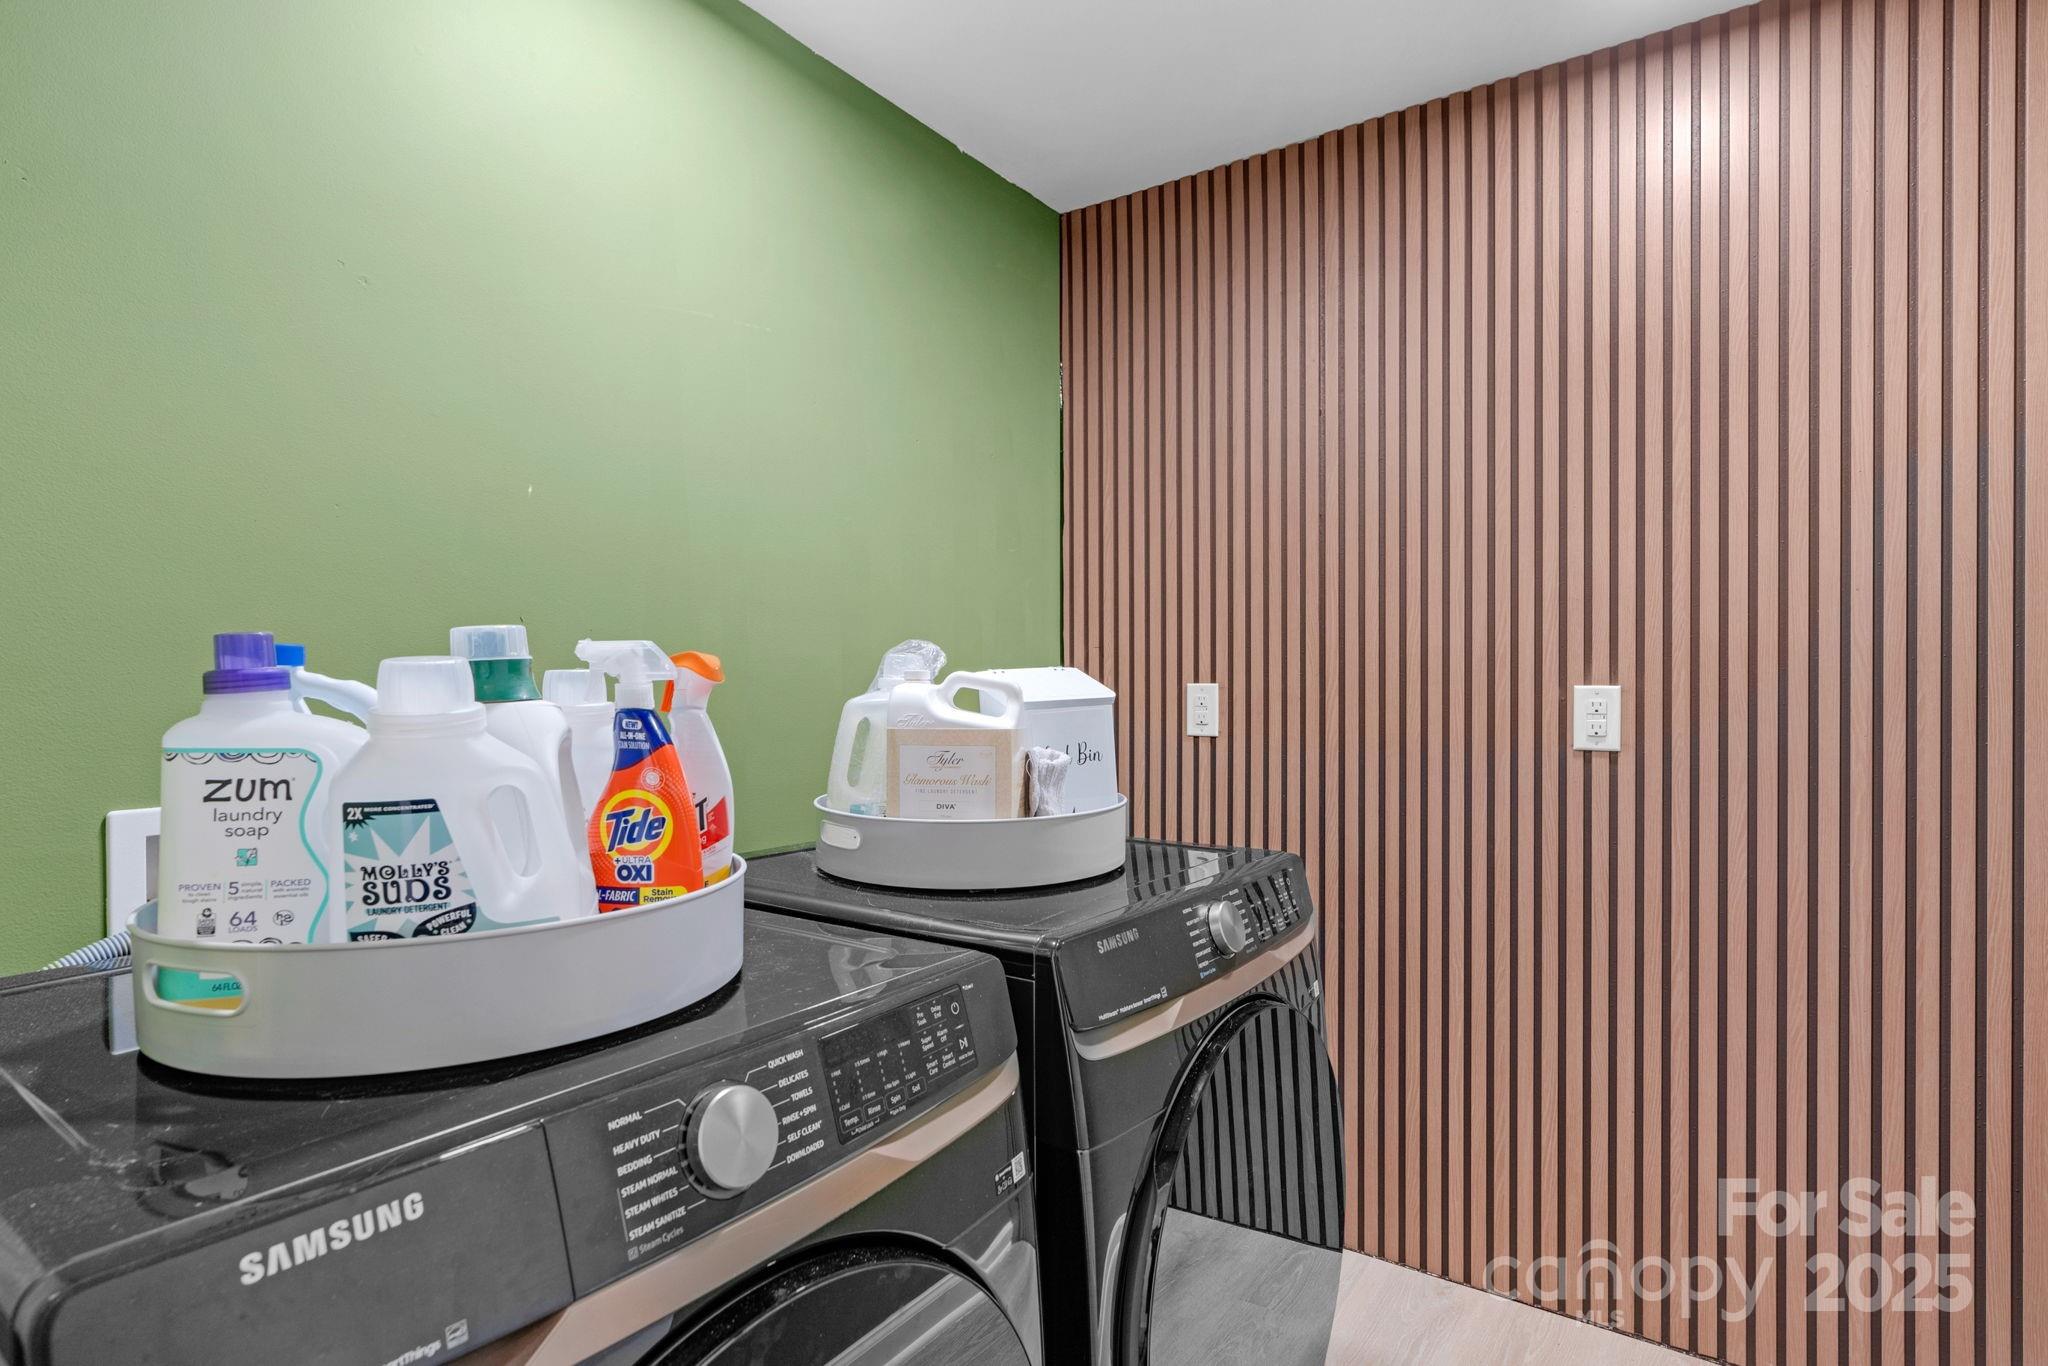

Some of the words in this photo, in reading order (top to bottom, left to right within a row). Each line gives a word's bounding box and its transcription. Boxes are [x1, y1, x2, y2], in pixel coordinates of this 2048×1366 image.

[629, 741, 650, 750] SOLUTION
[926, 750, 964, 771] Tyler
[1076, 741, 1103, 766] Bin
[903, 773, 957, 786] Glamorous
[959, 774, 992, 786] Wash
[203, 778, 292, 802] zum
[213, 807, 283, 824] laundry
[347, 808, 363, 820] 2X
[225, 826, 269, 840] soap
[606, 808, 666, 852] Tide
[360, 861, 450, 881] MOLLY'S
[617, 865, 653, 882] OXI
[178, 883, 222, 892] PROVEN
[228, 881, 240, 895] 5
[270, 879, 311, 887] PACKED
[362, 876, 452, 906] SUDS
[651, 888, 673, 896] Stain
[643, 895, 677, 903] Remo
[367, 906, 402, 916] LAUNDRY
[404, 902, 448, 913] DETERGENT
[229, 911, 257, 927] 64
[426, 909, 472, 931] POWERFUL
[441, 922, 468, 936] CLEAN
[1096, 928, 1140, 954] SAMSUNG
[930, 1005, 942, 1013] Delay
[936, 1028, 948, 1037] Alarm
[921, 1035, 932, 1045] Super
[922, 1041, 934, 1052] Speed
[767, 1055, 785, 1069] QUICK
[784, 1049, 804, 1064] WASH
[942, 1052, 954, 1061] Smart
[942, 1058, 956, 1069] Control
[926, 1060, 938, 1070] Smart
[929, 1067, 938, 1076] Care
[778, 1069, 809, 1088] DELICATES
[790, 1086, 814, 1101] TOWELS
[911, 1083, 921, 1093] Soil
[890, 1094, 901, 1104] Spin
[867, 1104, 881, 1115] Rinse
[608, 1111, 642, 1131] NORMAL
[612, 1138, 639, 1156] HEAVY
[640, 1130, 660, 1145] DUTY
[787, 1130, 802, 1143] SELF
[786, 1139, 825, 1164] DOWNLOADED
[617, 1155, 653, 1177] BEDDING
[620, 1181, 648, 1198] STEAM
[647, 1166, 679, 1186] NORMAL
[625, 1203, 651, 1219] STEAM
[651, 1188, 679, 1206] WHITES
[629, 1224, 655, 1242] STEAM
[655, 1206, 687, 1227] SANITIZE
[239, 1192, 424, 1286] SAMSUNG
[639, 1237, 662, 1254] Steam
[662, 1226, 684, 1243] Cycles
